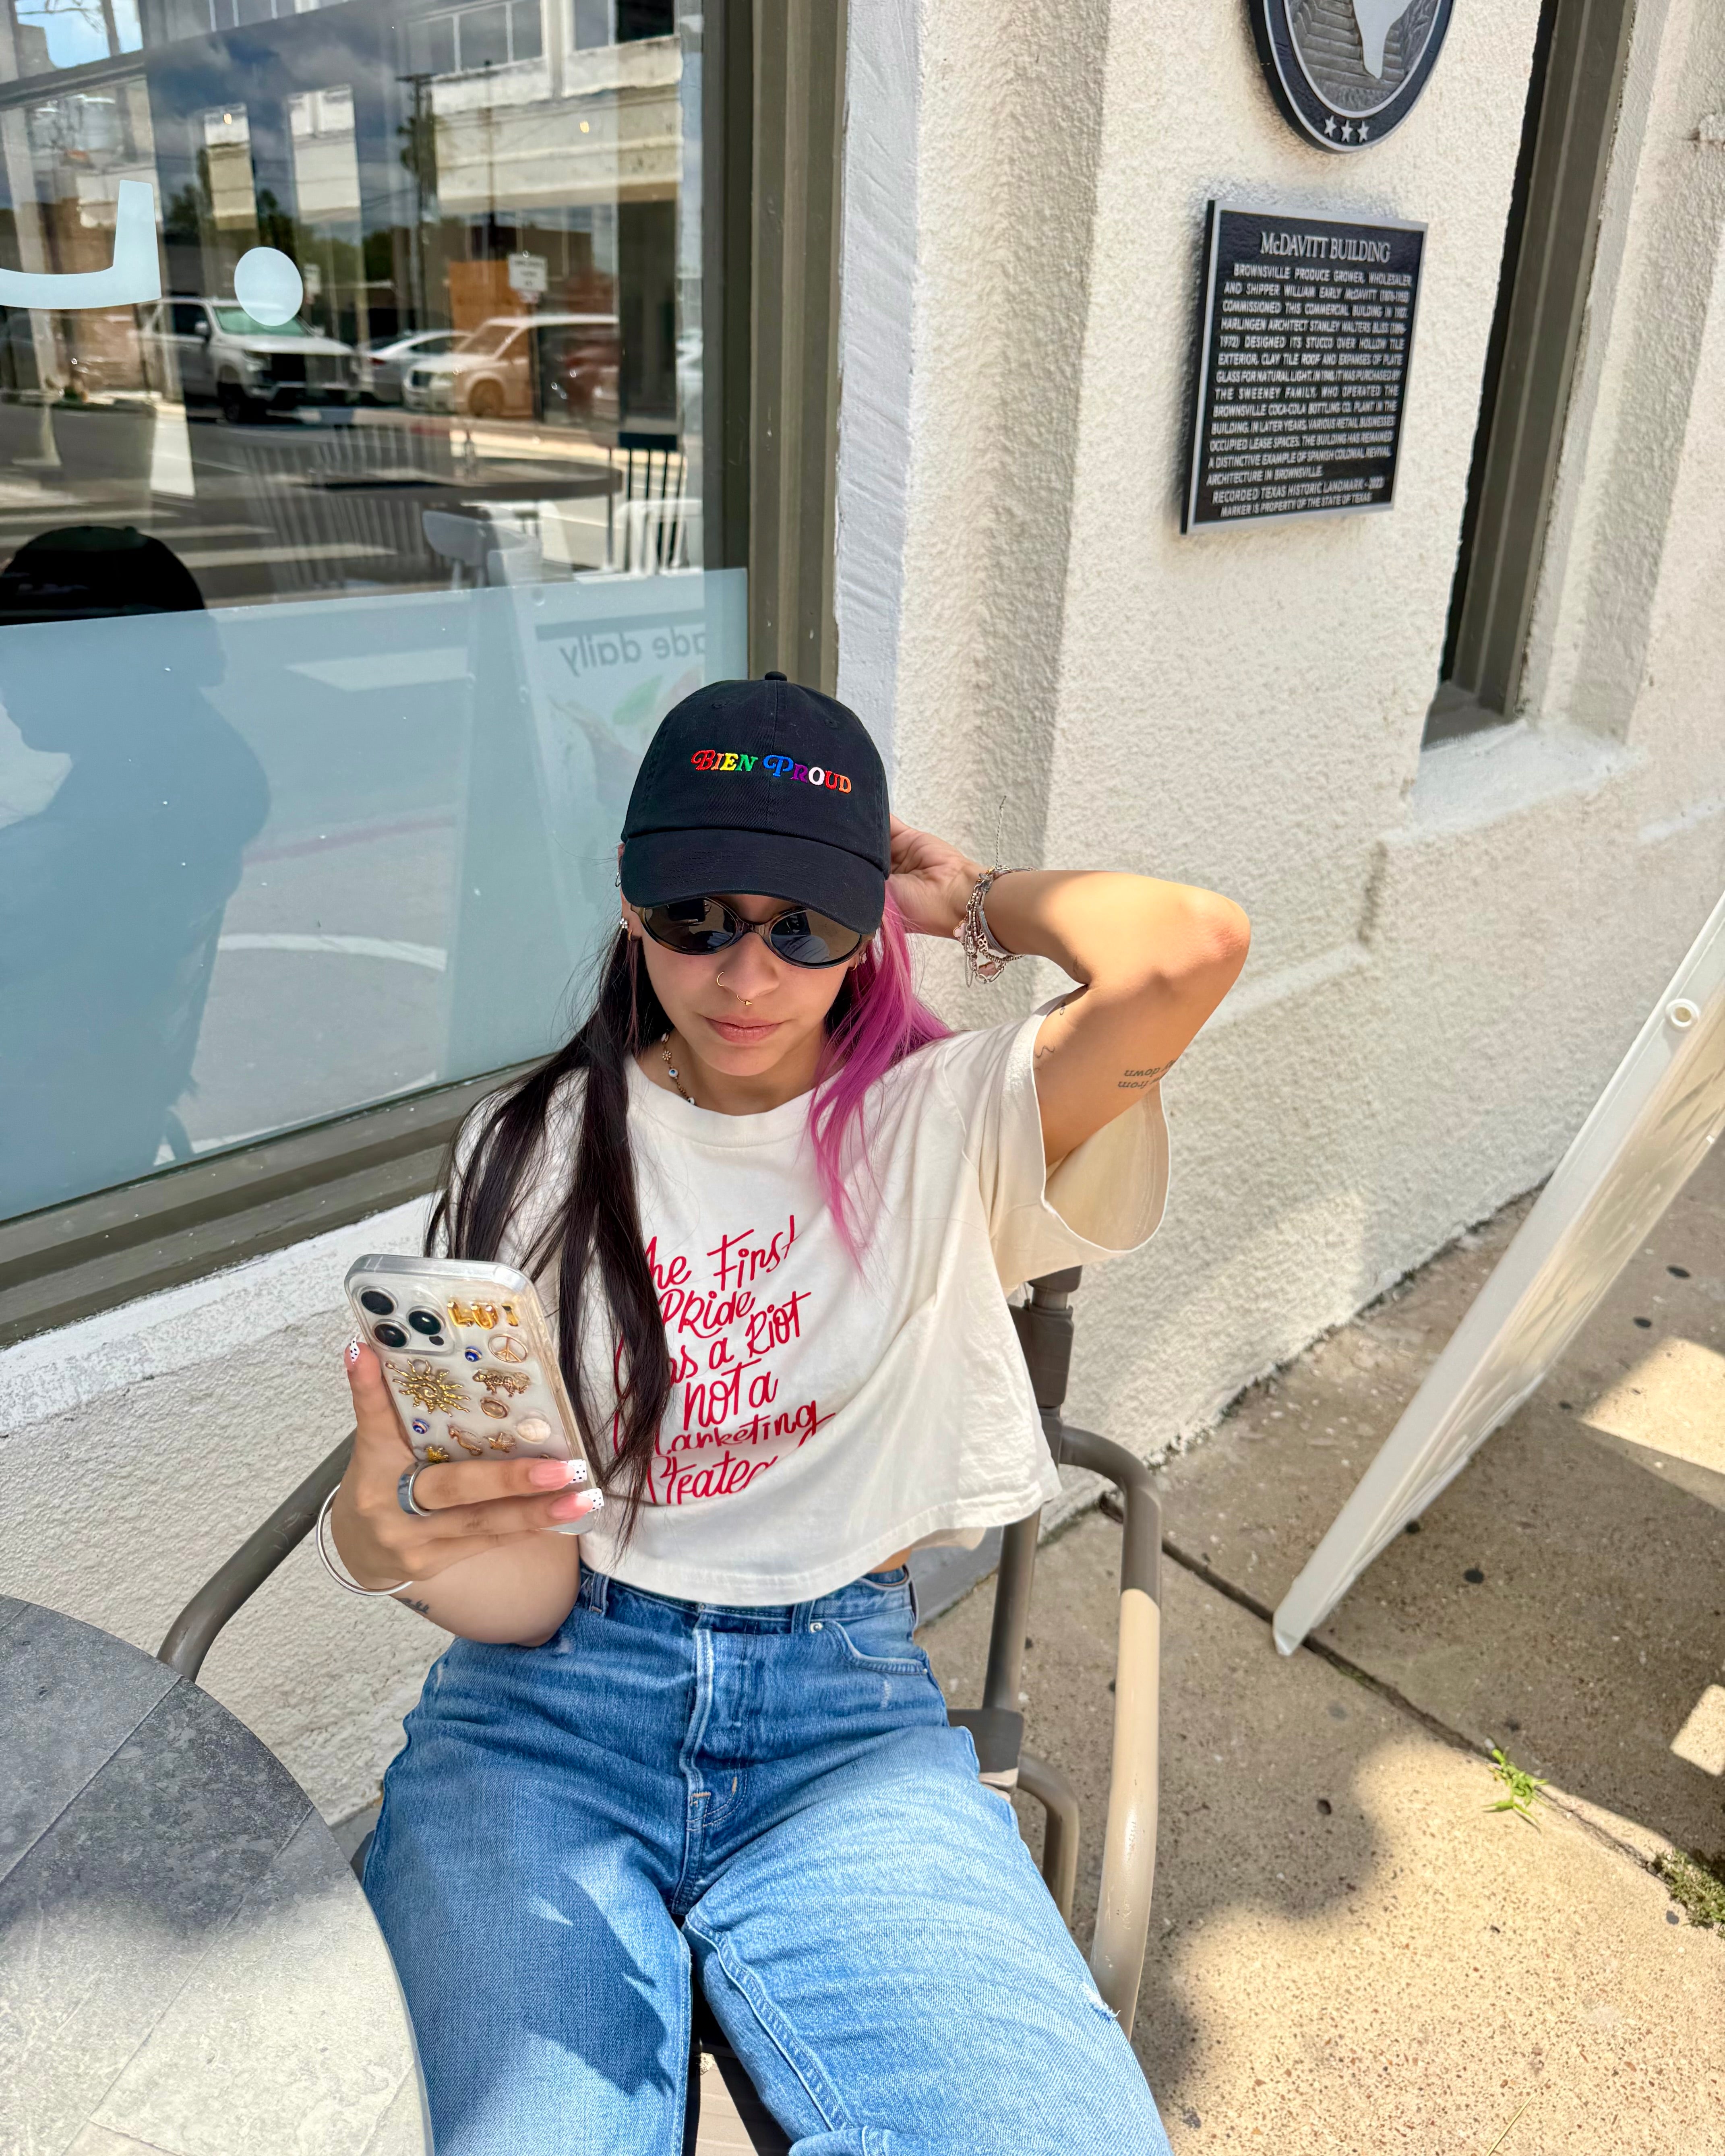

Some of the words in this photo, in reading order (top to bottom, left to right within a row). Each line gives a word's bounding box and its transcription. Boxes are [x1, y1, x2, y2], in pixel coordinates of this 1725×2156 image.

[1260, 231, 1329, 258] McDAVITT
[1330, 237, 1391, 263] BUILDING
[1233, 263, 1292, 279] BROWNSVILLE
[1294, 267, 1330, 281] PRODUCE
[1369, 272, 1412, 286] WHOLESALER
[1224, 281, 1243, 294] AND
[1246, 283, 1280, 296] SHIPPER
[1284, 284, 1316, 298] WILLIAM
[1319, 286, 1343, 299] EARLY
[1344, 287, 1378, 301] McDAVITT
[1222, 300, 1282, 314] COMMISSIONED
[1284, 302, 1302, 314] THIS
[1304, 303, 1349, 316] COMMERCIAL
[1352, 304, 1383, 318] BUILDING
[1384, 305, 1392, 318] IN
[1221, 316, 1267, 331] HARLINGEN
[1268, 318, 1309, 331] ARCHITECT
[1309, 319, 1340, 332] STANLEY
[1341, 320, 1371, 333] WALTERS
[1372, 321, 1389, 334] BLISS
[1244, 335, 1287, 349] DESIGNED
[1290, 336, 1303, 349] ITS
[1305, 336, 1334, 349] STUCCO
[1336, 336, 1356, 349] OVER
[1359, 337, 1387, 350] HOLLOW
[1390, 338, 1405, 350] TILE
[1218, 352, 1260, 366] EXTERIOR,
[1261, 352, 1282, 366] CLAY
[1282, 352, 1301, 365] TILE
[1301, 353, 1322, 366] ROOF
[1322, 353, 1338, 366] AND
[1338, 352, 1372, 366] EXPANSES
[1372, 353, 1383, 365] OF
[1383, 353, 1403, 366] PLATE
[1216, 369, 1241, 383] GLASS
[1241, 369, 1257, 382] FOR
[1257, 370, 1289, 382] NATURAL
[1313, 369, 1321, 382] IN
[1335, 369, 1342, 381] IT
[1342, 369, 1356, 381] WAS
[1356, 368, 1391, 381] PURCHASED
[1391, 368, 1402, 380] BY
[1215, 387, 1235, 400] THE
[1238, 387, 1282, 400] SWEENEY
[1284, 386, 1318, 399] FAMILY,
[1321, 385, 1340, 398] WHO
[1342, 384, 1382, 397] OPERATED
[1384, 384, 1400, 397] THE
[1213, 403, 1267, 418] BROWNSVILLE
[1268, 403, 1306, 415] COCA-COLA
[1308, 402, 1341, 414] BOTTLING
[1353, 400, 1375, 412] PLANT
[1375, 399, 1383, 411] IN
[1384, 399, 1398, 411] THE
[1250, 420, 1259, 433] IN
[1260, 419, 1284, 432] LATER
[1308, 416, 1336, 430] VARIOUS
[1337, 415, 1359, 429] RETAIL
[1359, 414, 1396, 428] BUSINESSES
[1210, 437, 1248, 452] OCCUPIED
[1249, 436, 1272, 449] LEASE
[1302, 434, 1316, 446] THE
[1316, 432, 1346, 446] BUILDING
[1347, 431, 1361, 443] HAS
[1361, 429, 1394, 442] REMAINED
[1208, 456, 1215, 469] A
[1216, 453, 1261, 469] DISTINCTIVE
[1262, 451, 1296, 465] EXAMPLE
[1297, 449, 1307, 462] OF
[1307, 449, 1334, 462] SPANISH
[1334, 446, 1365, 460] COLONIAL
[1365, 445, 1392, 458] REVIVAL
[1206, 468, 1264, 486] ARCHITECTURE
[1264, 468, 1273, 481] IN
[1212, 487, 1260, 504] RECORDED
[1261, 484, 1287, 499] TEXAS
[1287, 481, 1322, 496] HISTORIC
[1323, 478, 1364, 493] LANDMARK
[1220, 503, 1252, 518] MARKER
[1252, 502, 1260, 514] IS
[1260, 499, 1296, 513] PROPERTY
[1297, 498, 1307, 510] OF
[1307, 497, 1321, 508] THE
[1321, 494, 1342, 506] STATE
[1342, 493, 1352, 504] OF
[1352, 492, 1372, 504] TEXAS
[691, 749, 758, 771] BIEN
[763, 755, 852, 793] PROUD
[1124, 1067, 1160, 1077] down
[645, 1236, 692, 1289] he
[707, 1215, 794, 1291] First
[709, 1337, 734, 1370] a
[749, 1371, 779, 1408] a
